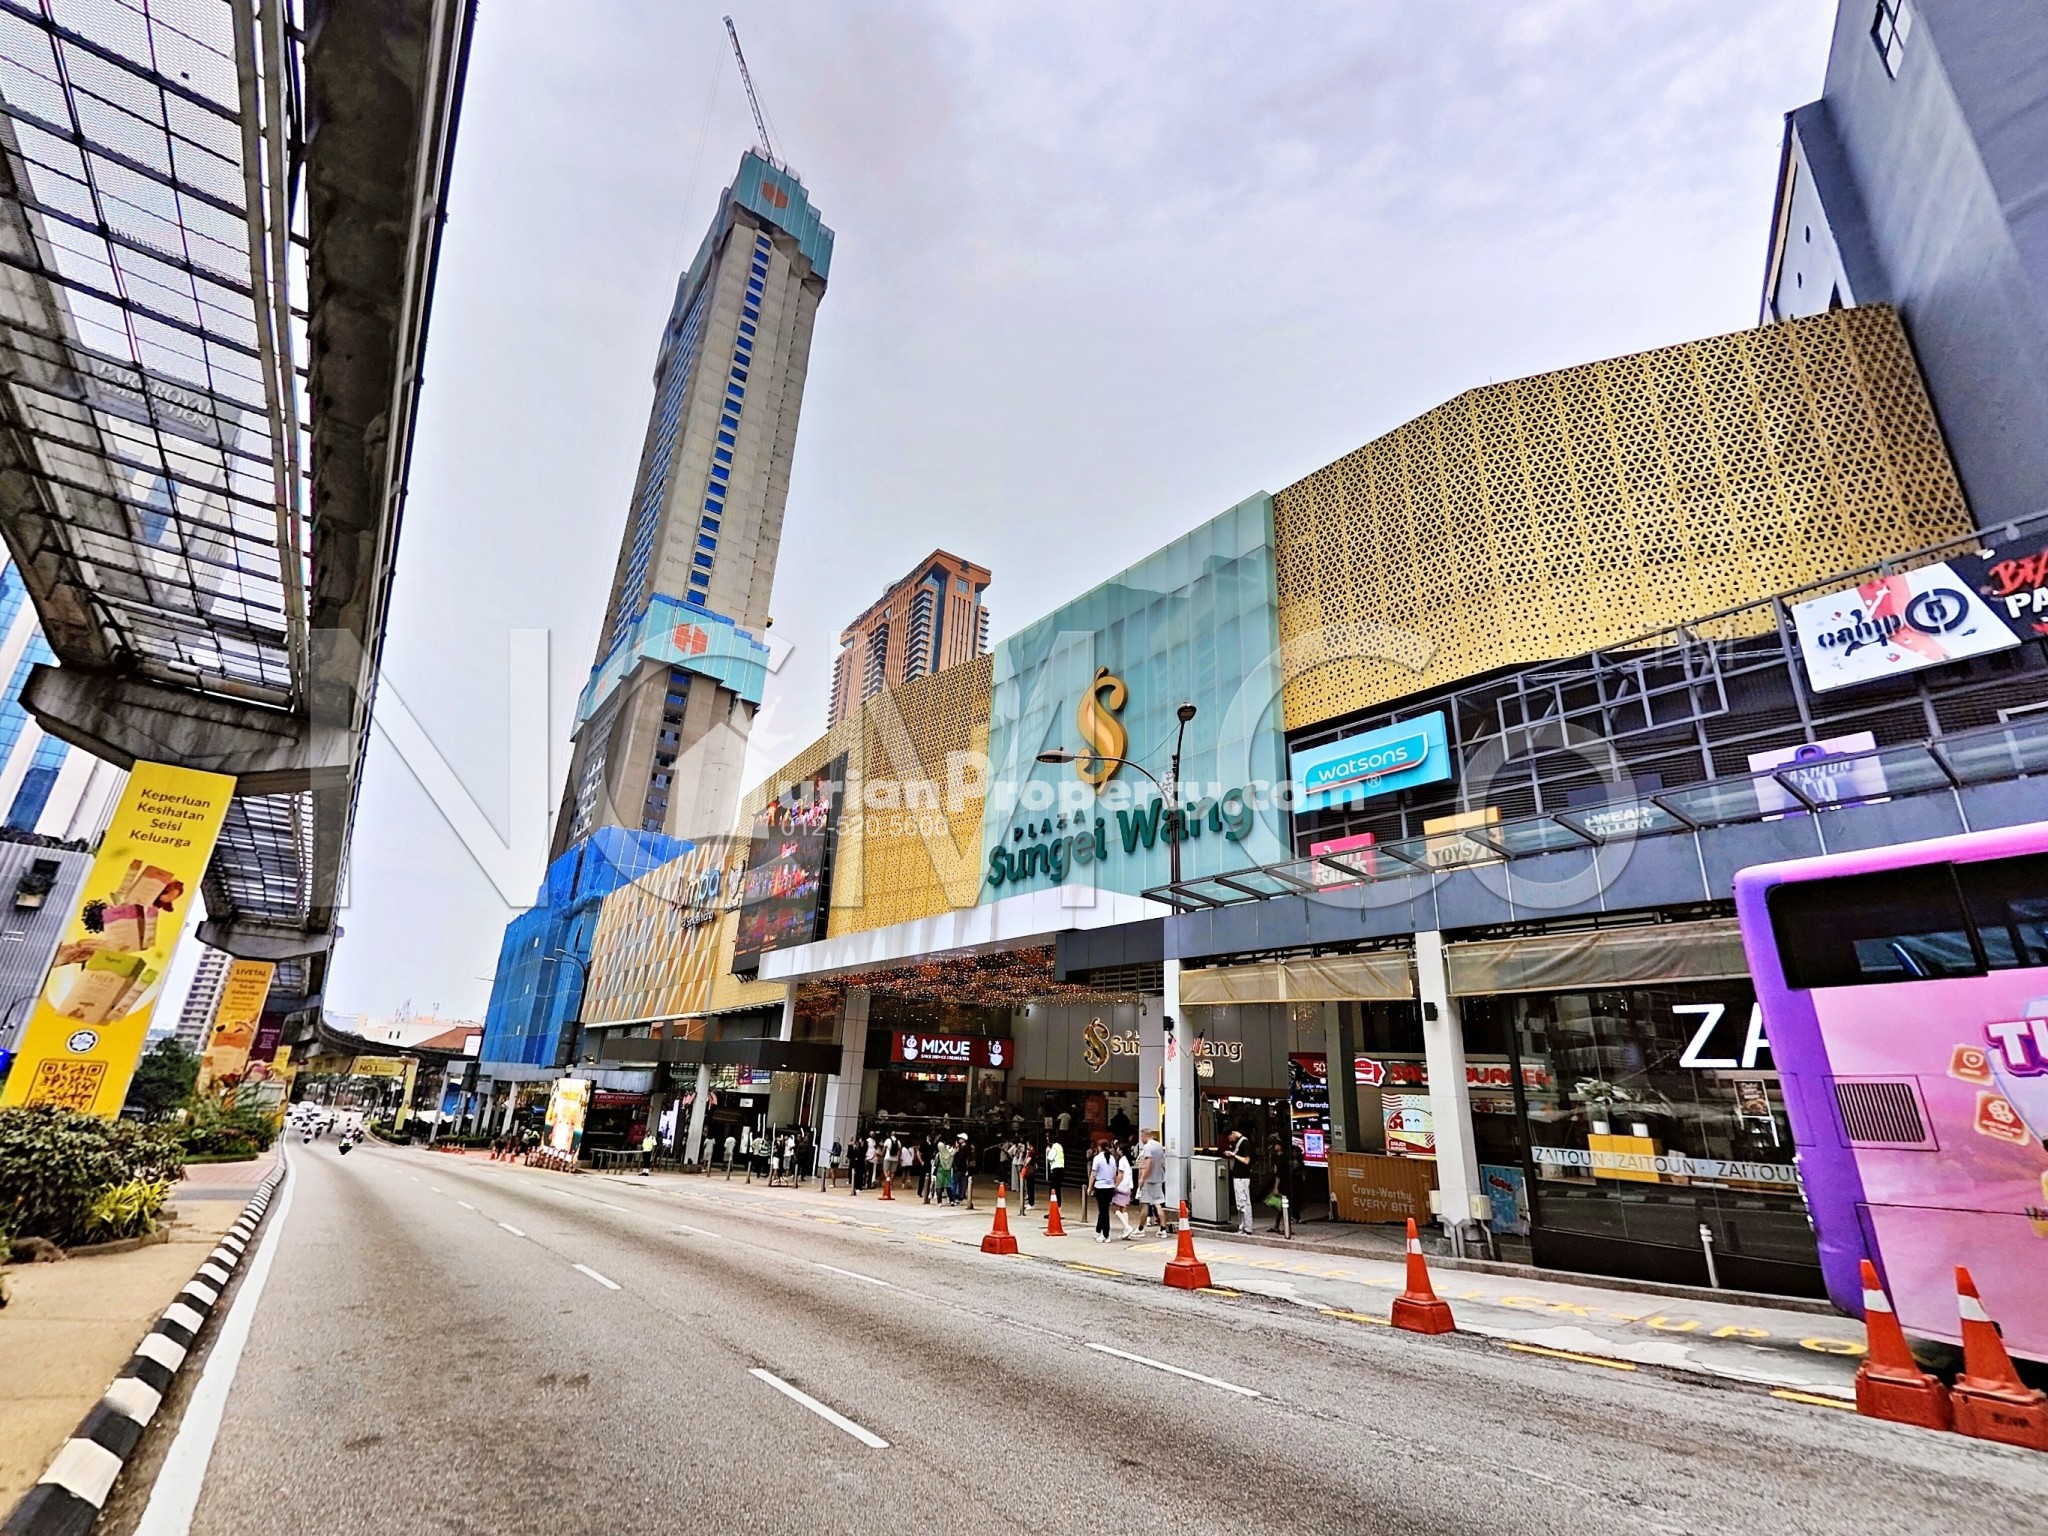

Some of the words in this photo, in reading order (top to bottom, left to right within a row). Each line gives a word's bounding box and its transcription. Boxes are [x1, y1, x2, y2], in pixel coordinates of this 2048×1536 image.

[1318, 746, 1408, 783] watsons
[141, 788, 210, 809] Keperluan
[136, 802, 205, 821] Kesihatan
[149, 818, 183, 831] Seisi
[1014, 808, 1085, 842] PLAZA
[129, 829, 192, 848] Keluarga
[988, 818, 1107, 887] Sungei
[1115, 784, 1256, 854] Wang
[921, 1038, 971, 1056] MIXUE
[1304, 1101, 1329, 1109] rewards
[1534, 1148, 1605, 1167] ZAITOUN
[1617, 1154, 1696, 1175] ZAITOUN
[1353, 1197, 1387, 1210] EVERY
[1391, 1202, 1415, 1214] BITE
